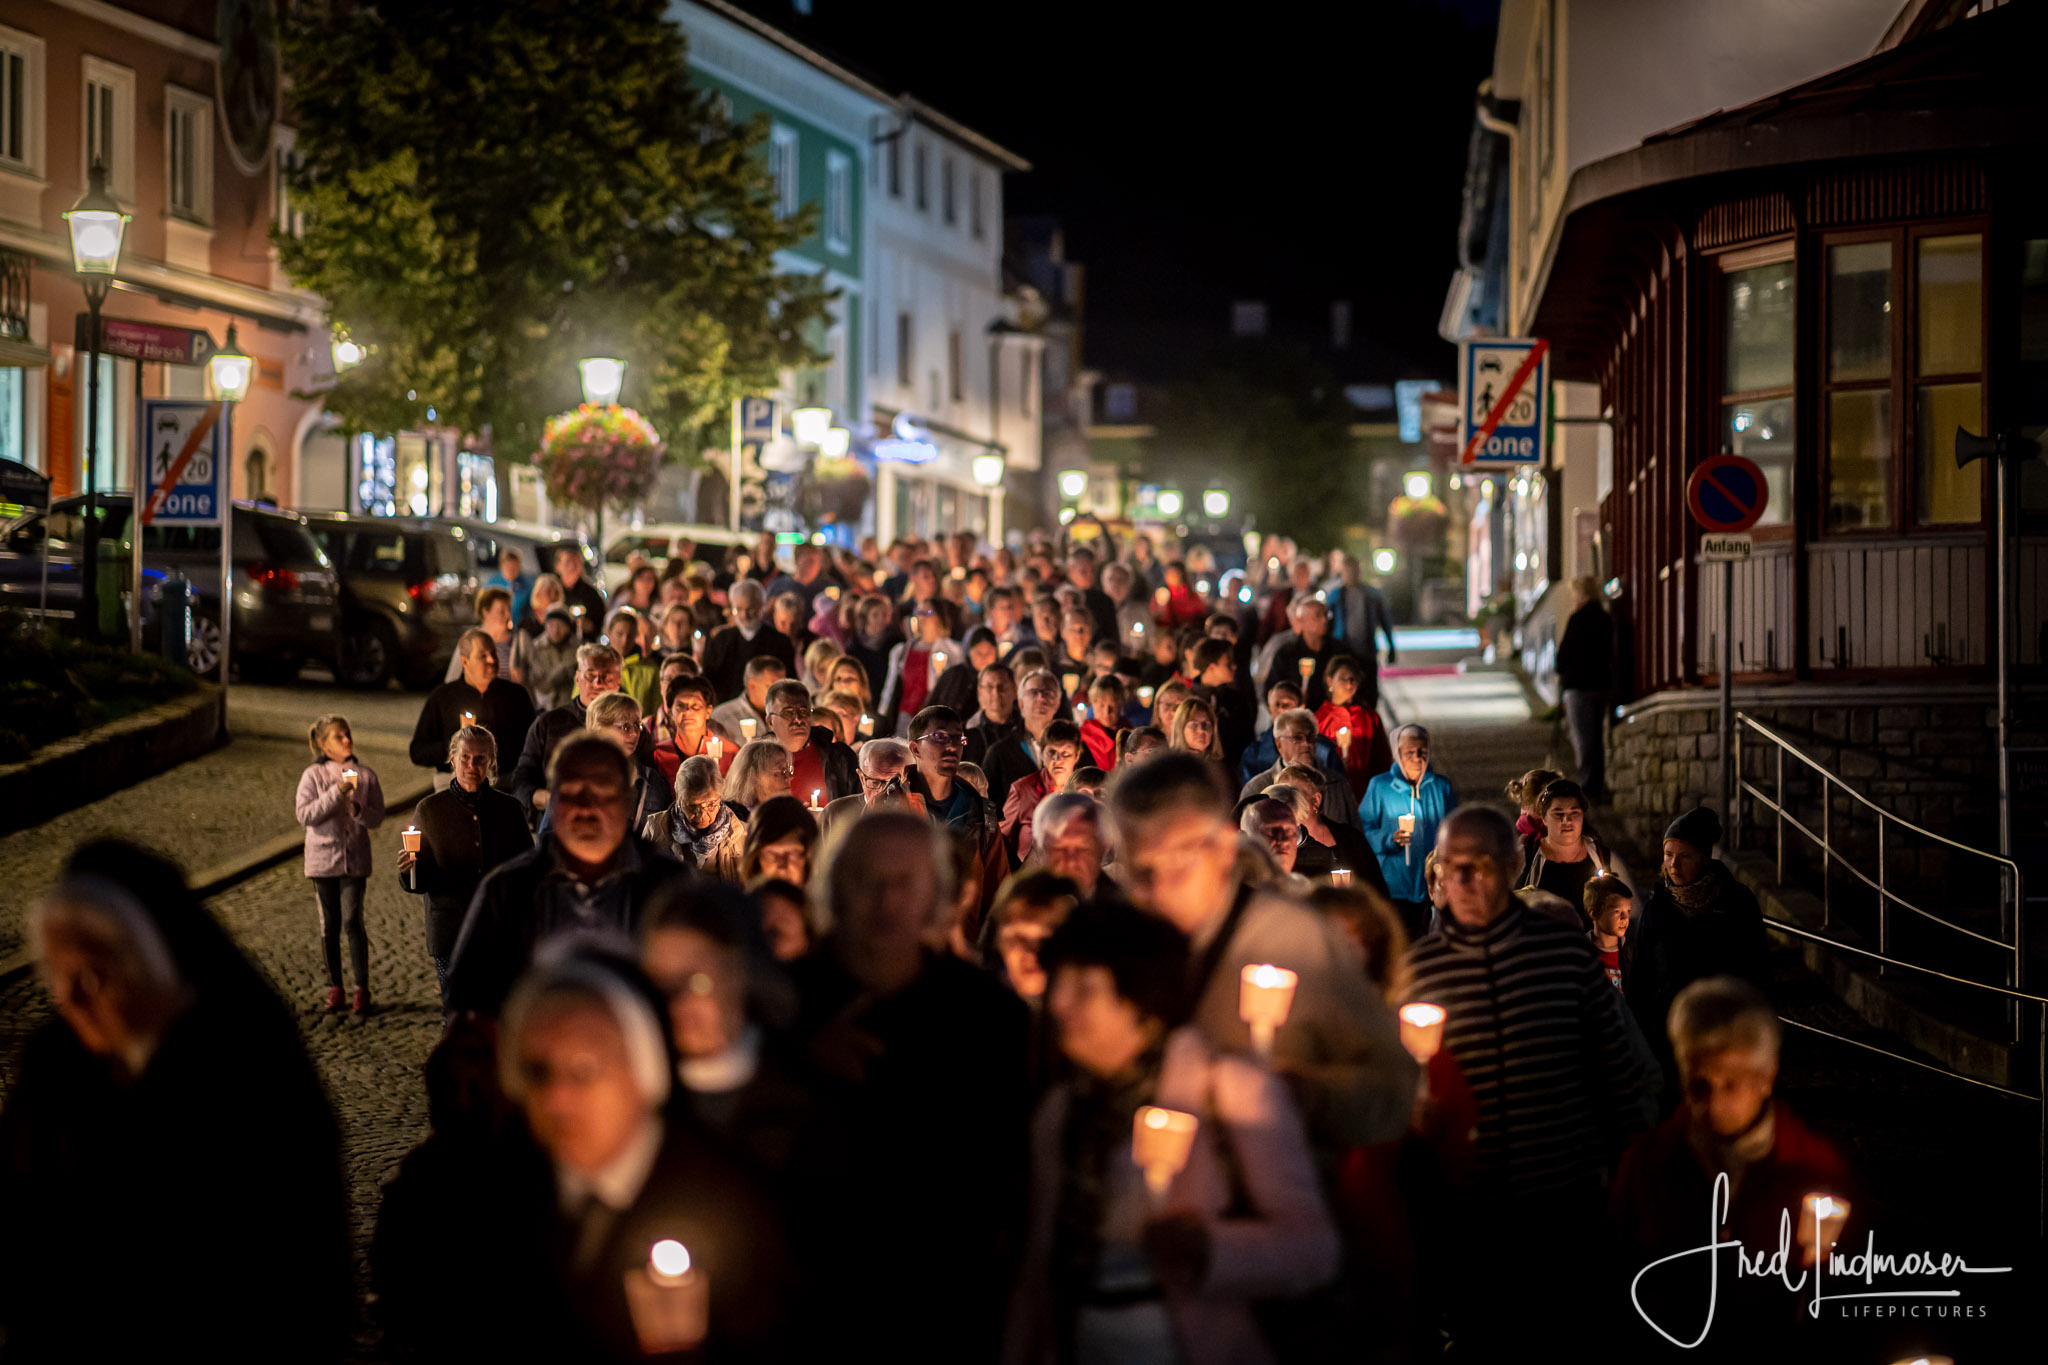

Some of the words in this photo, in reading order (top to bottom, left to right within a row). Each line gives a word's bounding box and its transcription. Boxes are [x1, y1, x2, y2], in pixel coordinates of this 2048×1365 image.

[191, 334, 207, 361] P
[745, 399, 770, 428] P
[1509, 401, 1531, 420] 20
[1472, 431, 1534, 457] Zone
[187, 460, 208, 479] 20
[152, 488, 211, 515] Zone
[1704, 538, 1751, 556] Anfang
